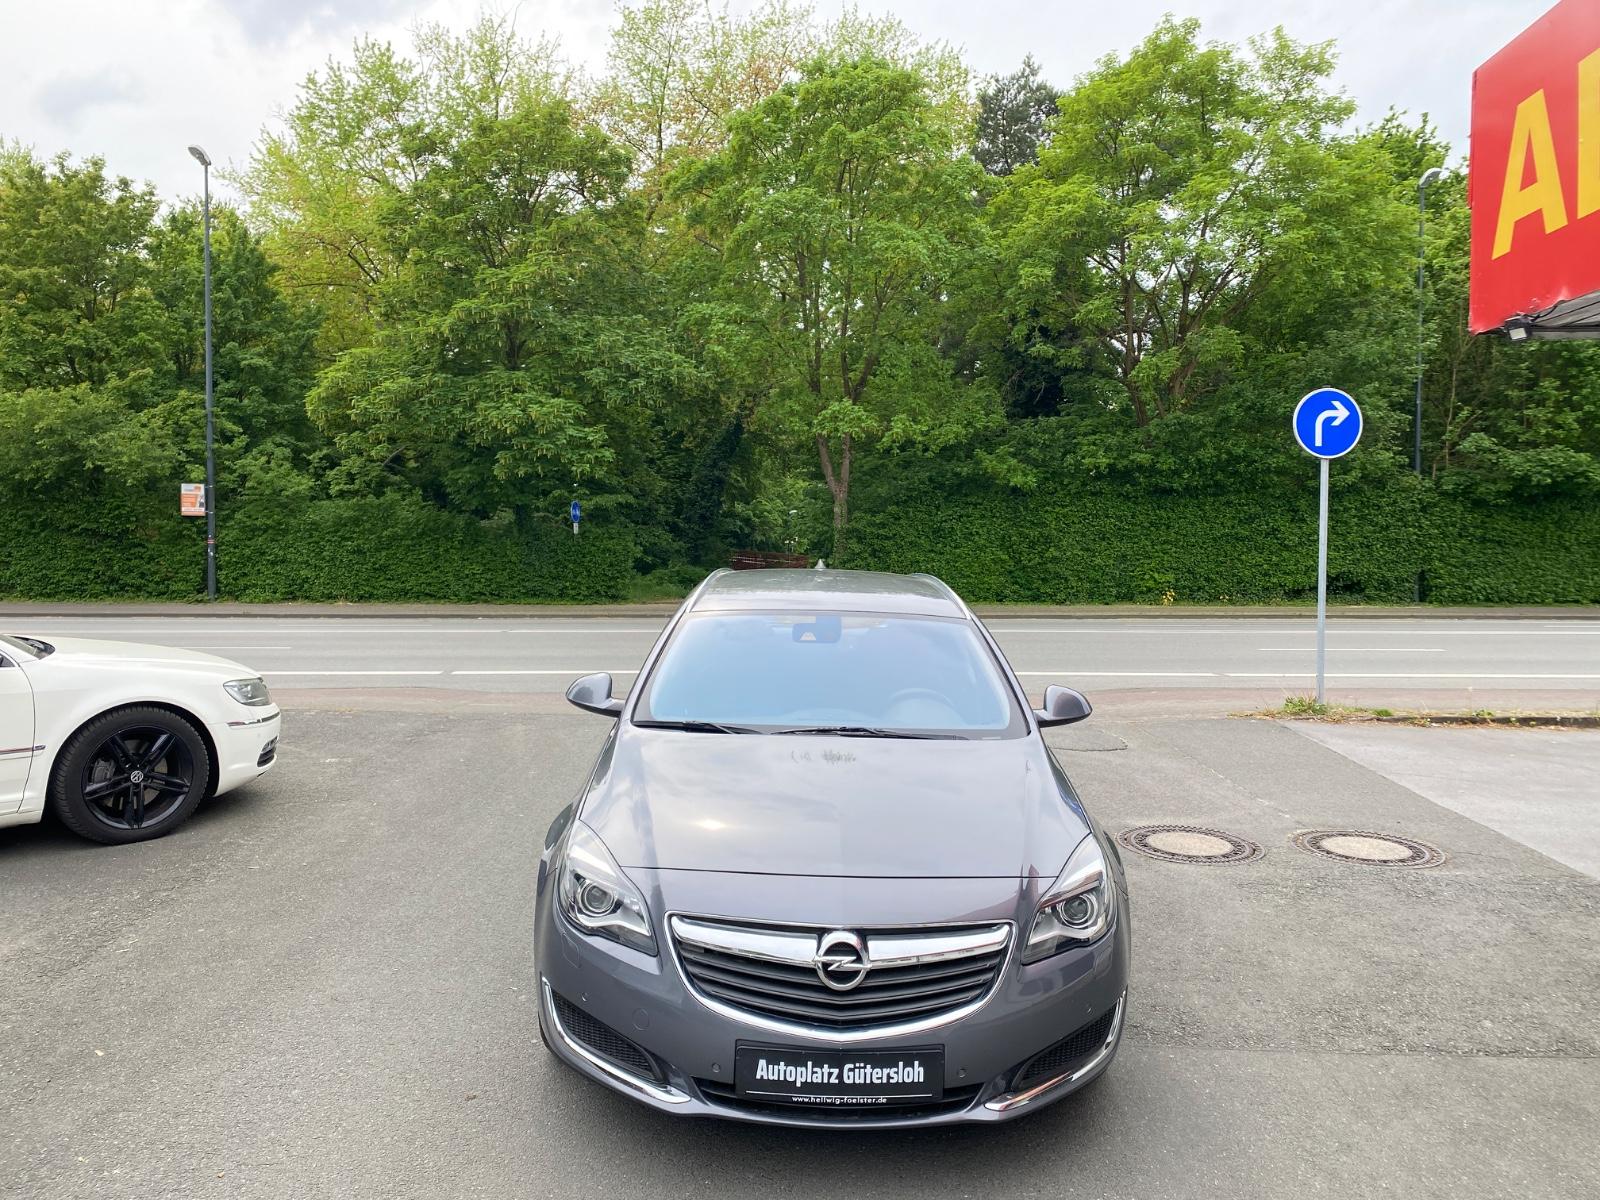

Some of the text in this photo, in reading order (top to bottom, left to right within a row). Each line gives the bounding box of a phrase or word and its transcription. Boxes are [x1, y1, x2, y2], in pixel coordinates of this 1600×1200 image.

[756, 1059, 924, 1087] Autoplatz Gütersloh
[791, 1096, 888, 1105] www.hellwig-foelster.de
